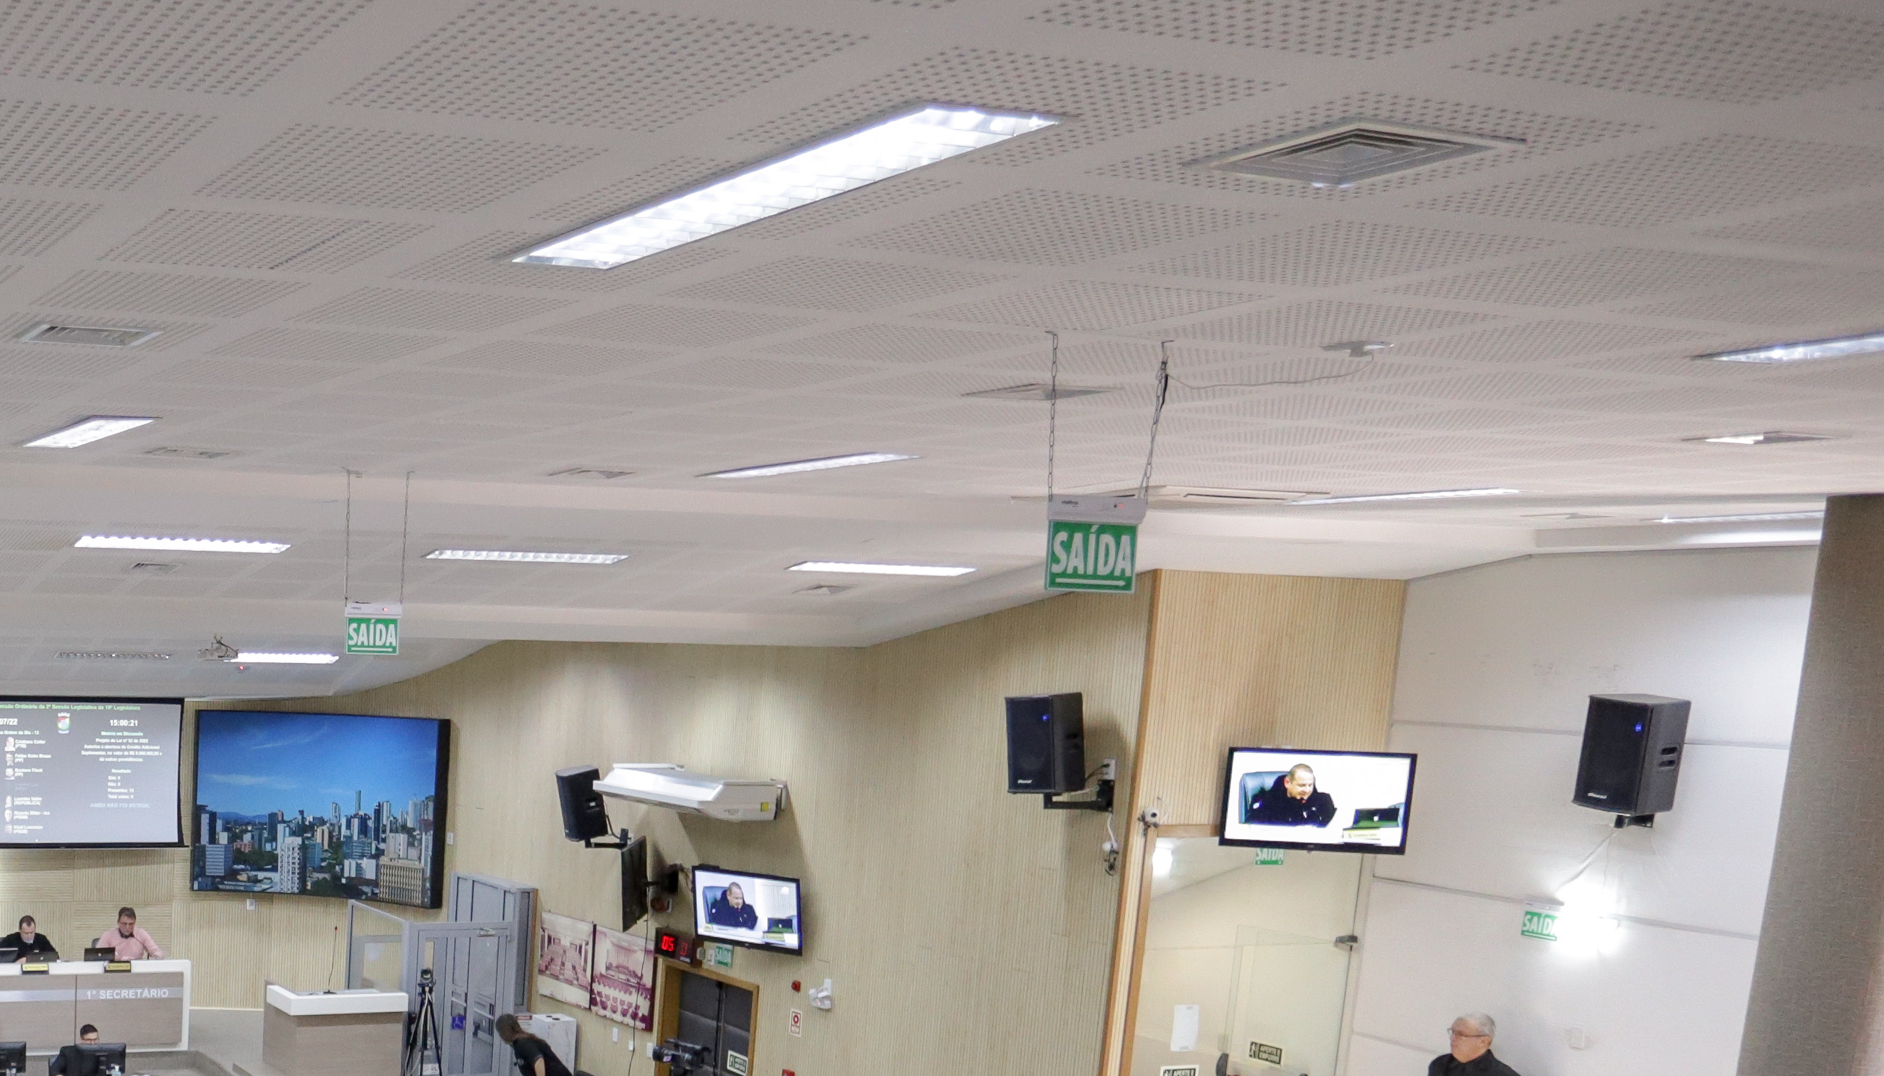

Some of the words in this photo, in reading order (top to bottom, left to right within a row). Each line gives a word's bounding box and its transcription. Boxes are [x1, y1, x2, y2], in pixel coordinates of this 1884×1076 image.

[1051, 525, 1132, 577] SAÍDA
[348, 619, 397, 646] SAÍDA
[109, 719, 138, 727] 15:00:21
[661, 935, 675, 951] 05
[99, 988, 169, 1000] SECRETÁRIO
